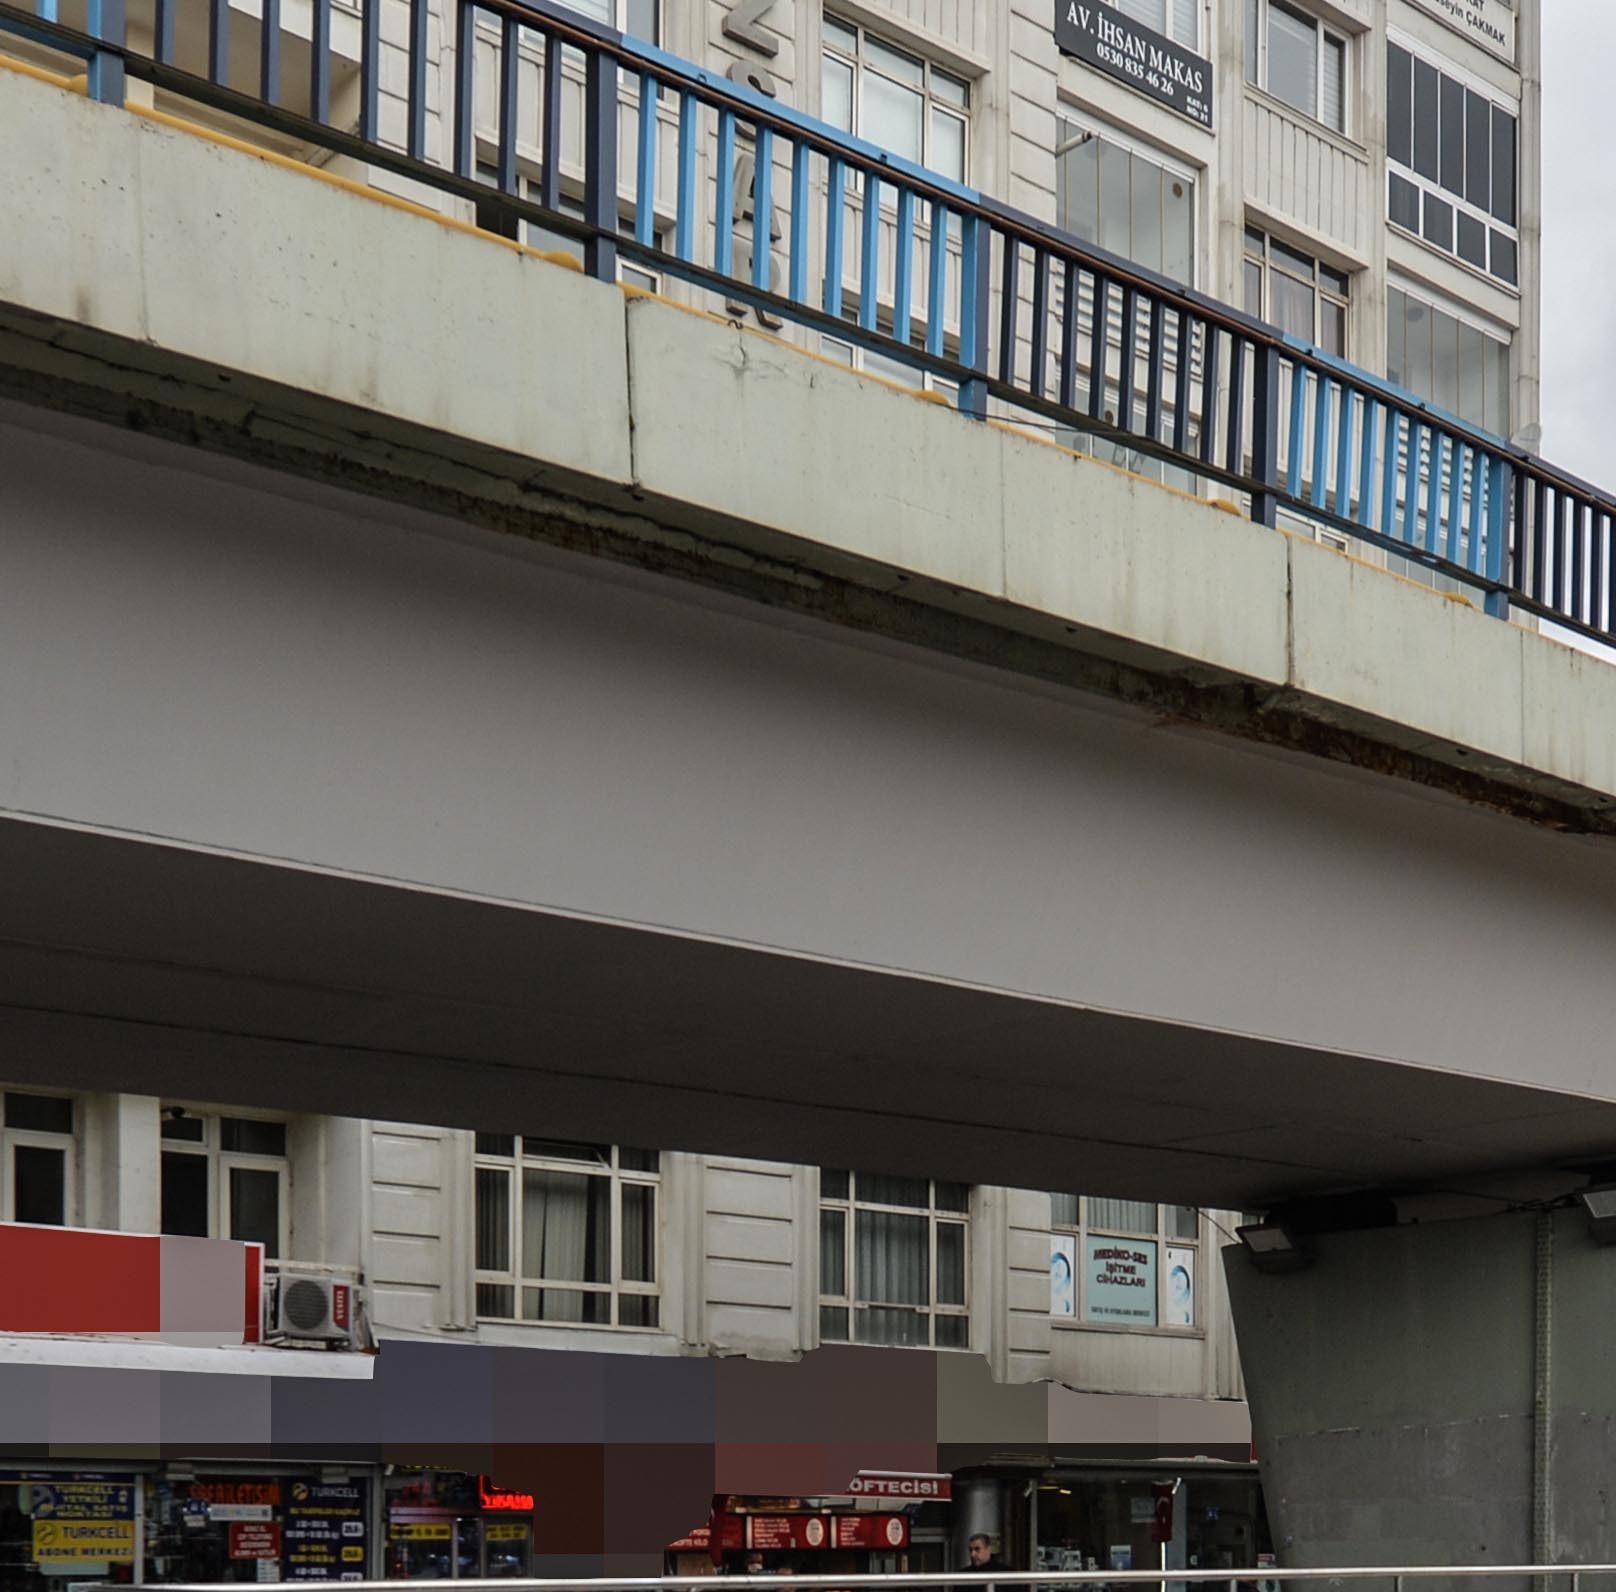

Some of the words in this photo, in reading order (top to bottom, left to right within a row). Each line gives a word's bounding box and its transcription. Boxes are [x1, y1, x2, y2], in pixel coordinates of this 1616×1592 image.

[1466, 11, 1506, 47] ÇAKMAK
[1067, 1, 1095, 35] AV.
[1097, 11, 1147, 63] İHSAN
[1149, 45, 1203, 93] MAKAS
[1097, 42, 1124, 71] 0530
[1125, 59, 1145, 80] 835
[1146, 70, 1160, 88] 46
[1161, 77, 1174, 96] 26
[1095, 1273, 1146, 1288] CİHAZLARI
[310, 1486, 360, 1498] TURKCELL
[62, 1526, 130, 1540] TURKCELL
